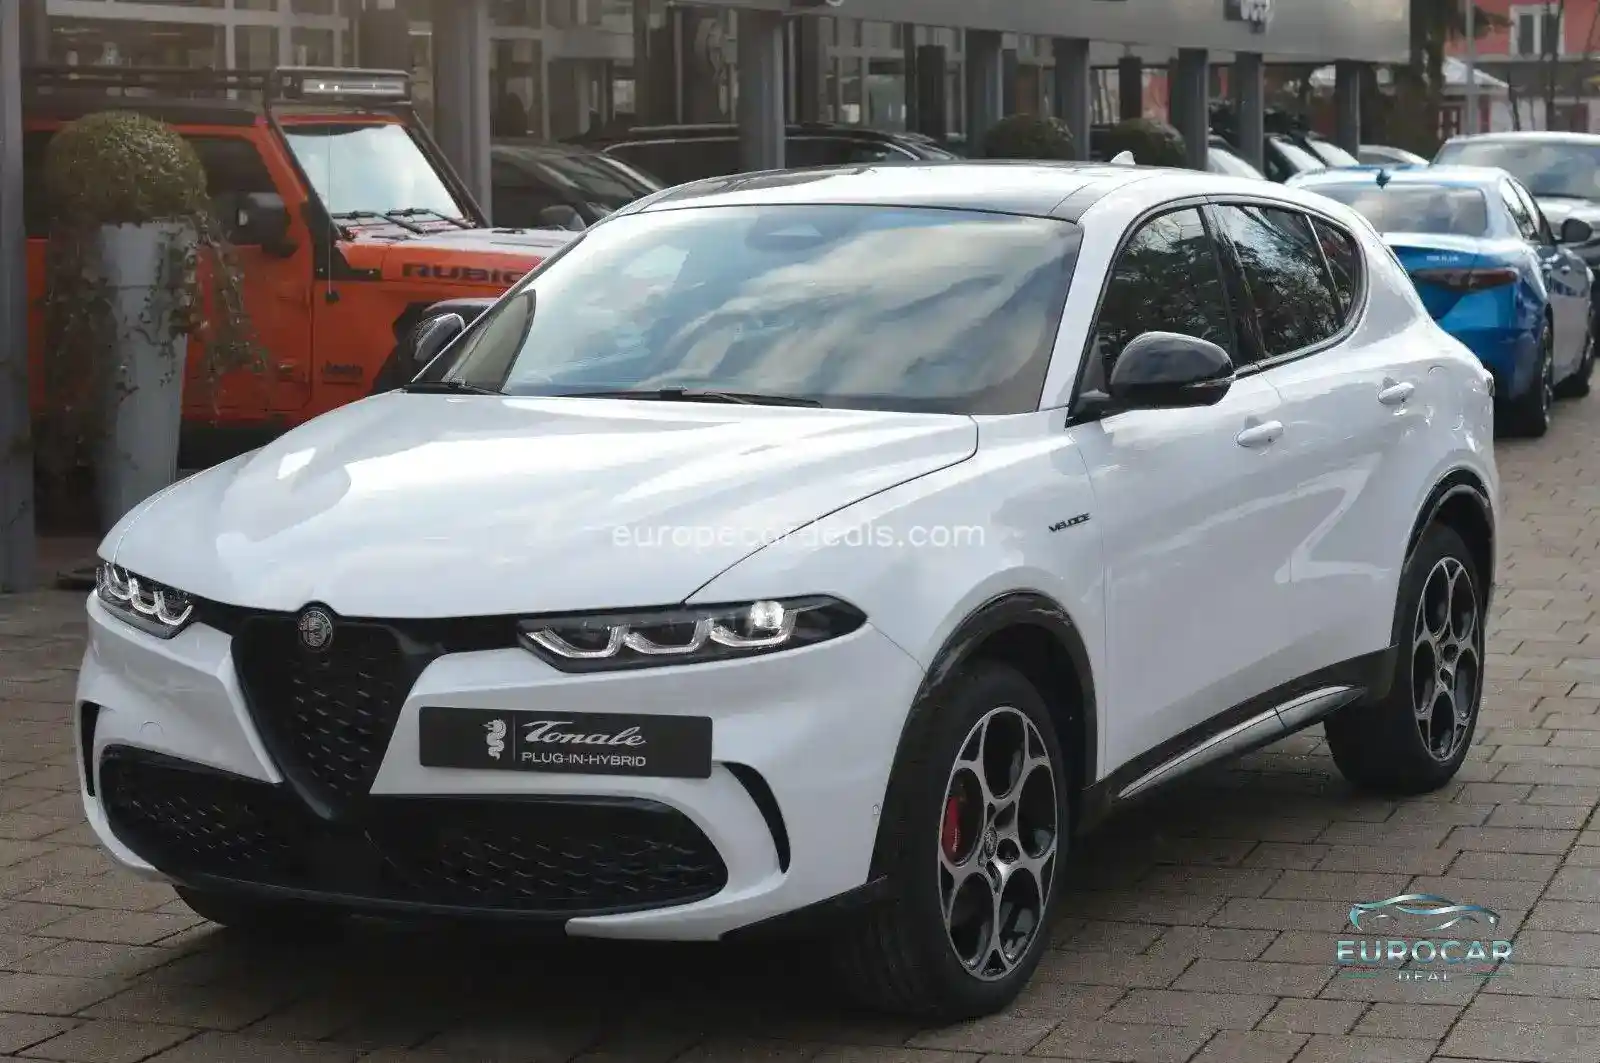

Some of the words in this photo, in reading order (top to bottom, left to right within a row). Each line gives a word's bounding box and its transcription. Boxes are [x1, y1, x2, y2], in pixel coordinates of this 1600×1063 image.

[1048, 512, 1091, 532] VELOCE
[521, 720, 647, 746] Tonale
[521, 751, 647, 767] PLUG-IN-HYBRID
